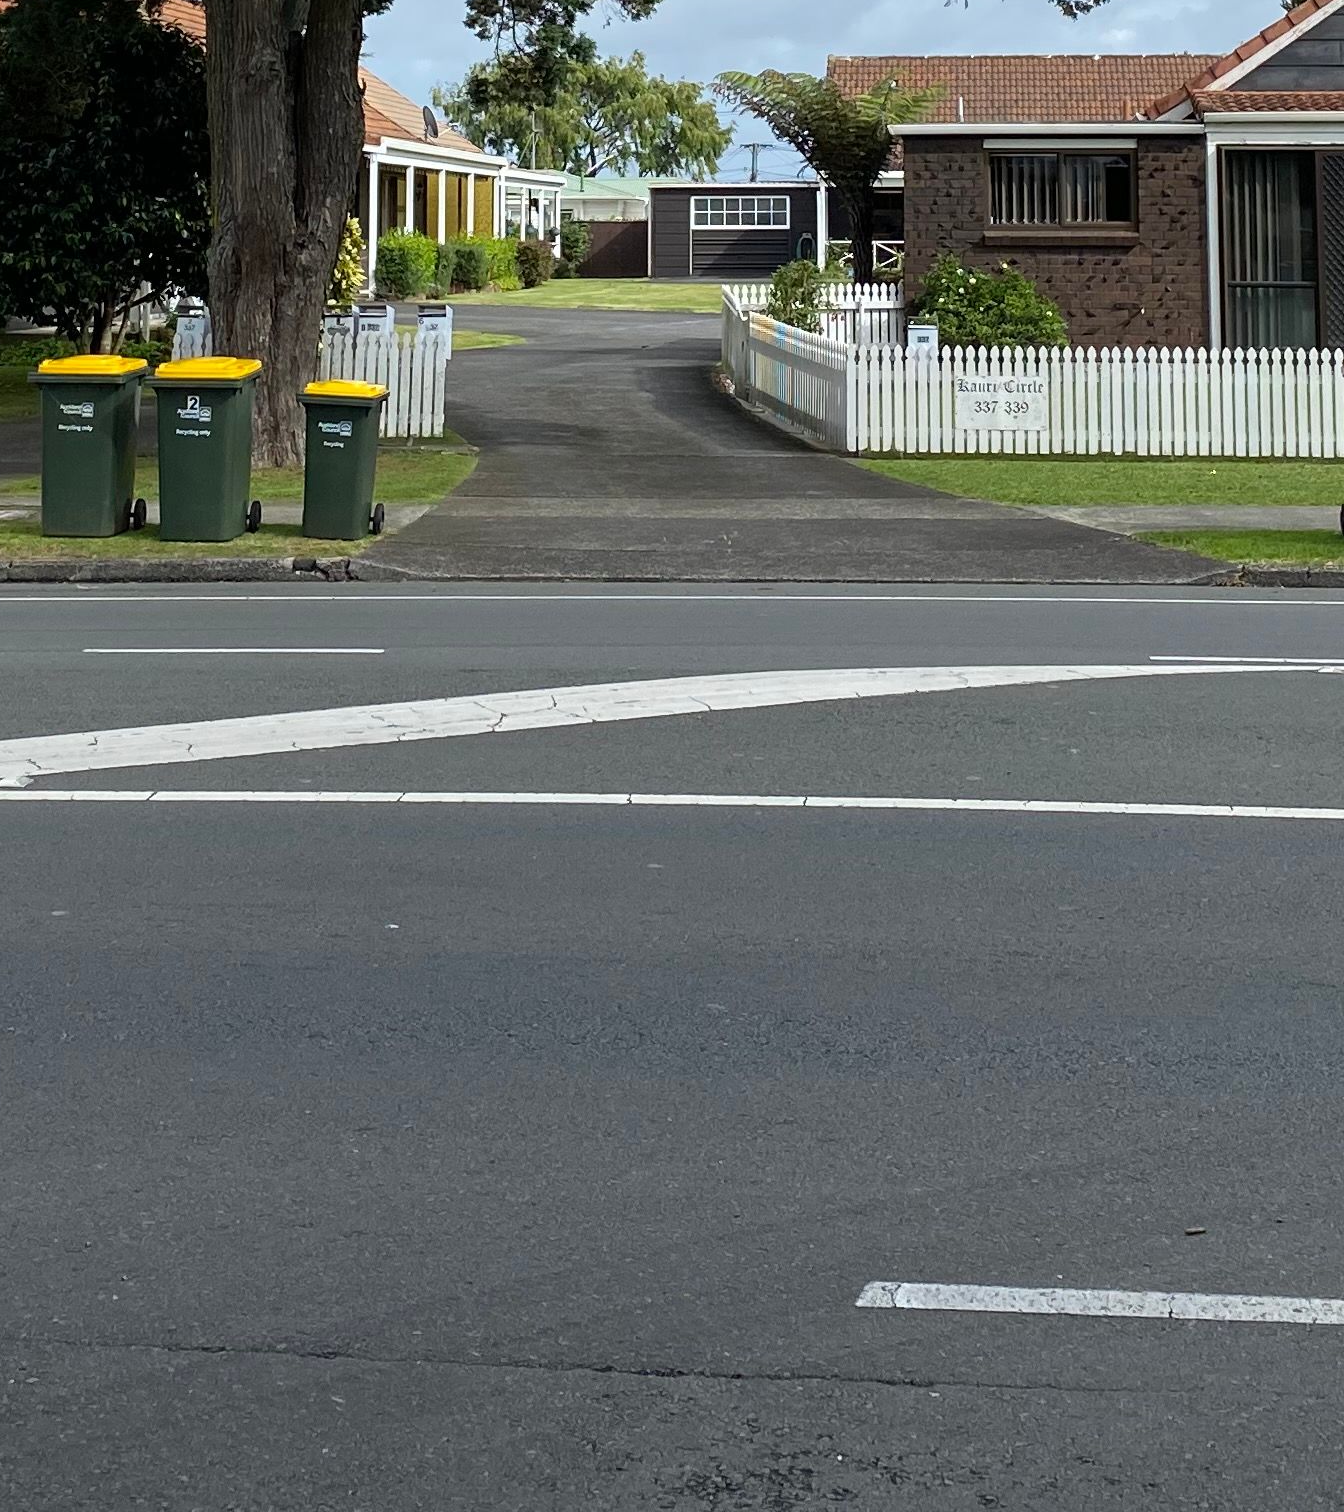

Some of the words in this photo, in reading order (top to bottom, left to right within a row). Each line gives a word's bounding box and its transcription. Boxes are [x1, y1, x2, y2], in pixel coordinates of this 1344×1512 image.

[957, 378, 998, 393] Kauri
[1003, 379, 1044, 394] Circle
[189, 397, 198, 410] 2
[974, 400, 998, 414] 337
[1004, 400, 1029, 415] 339
